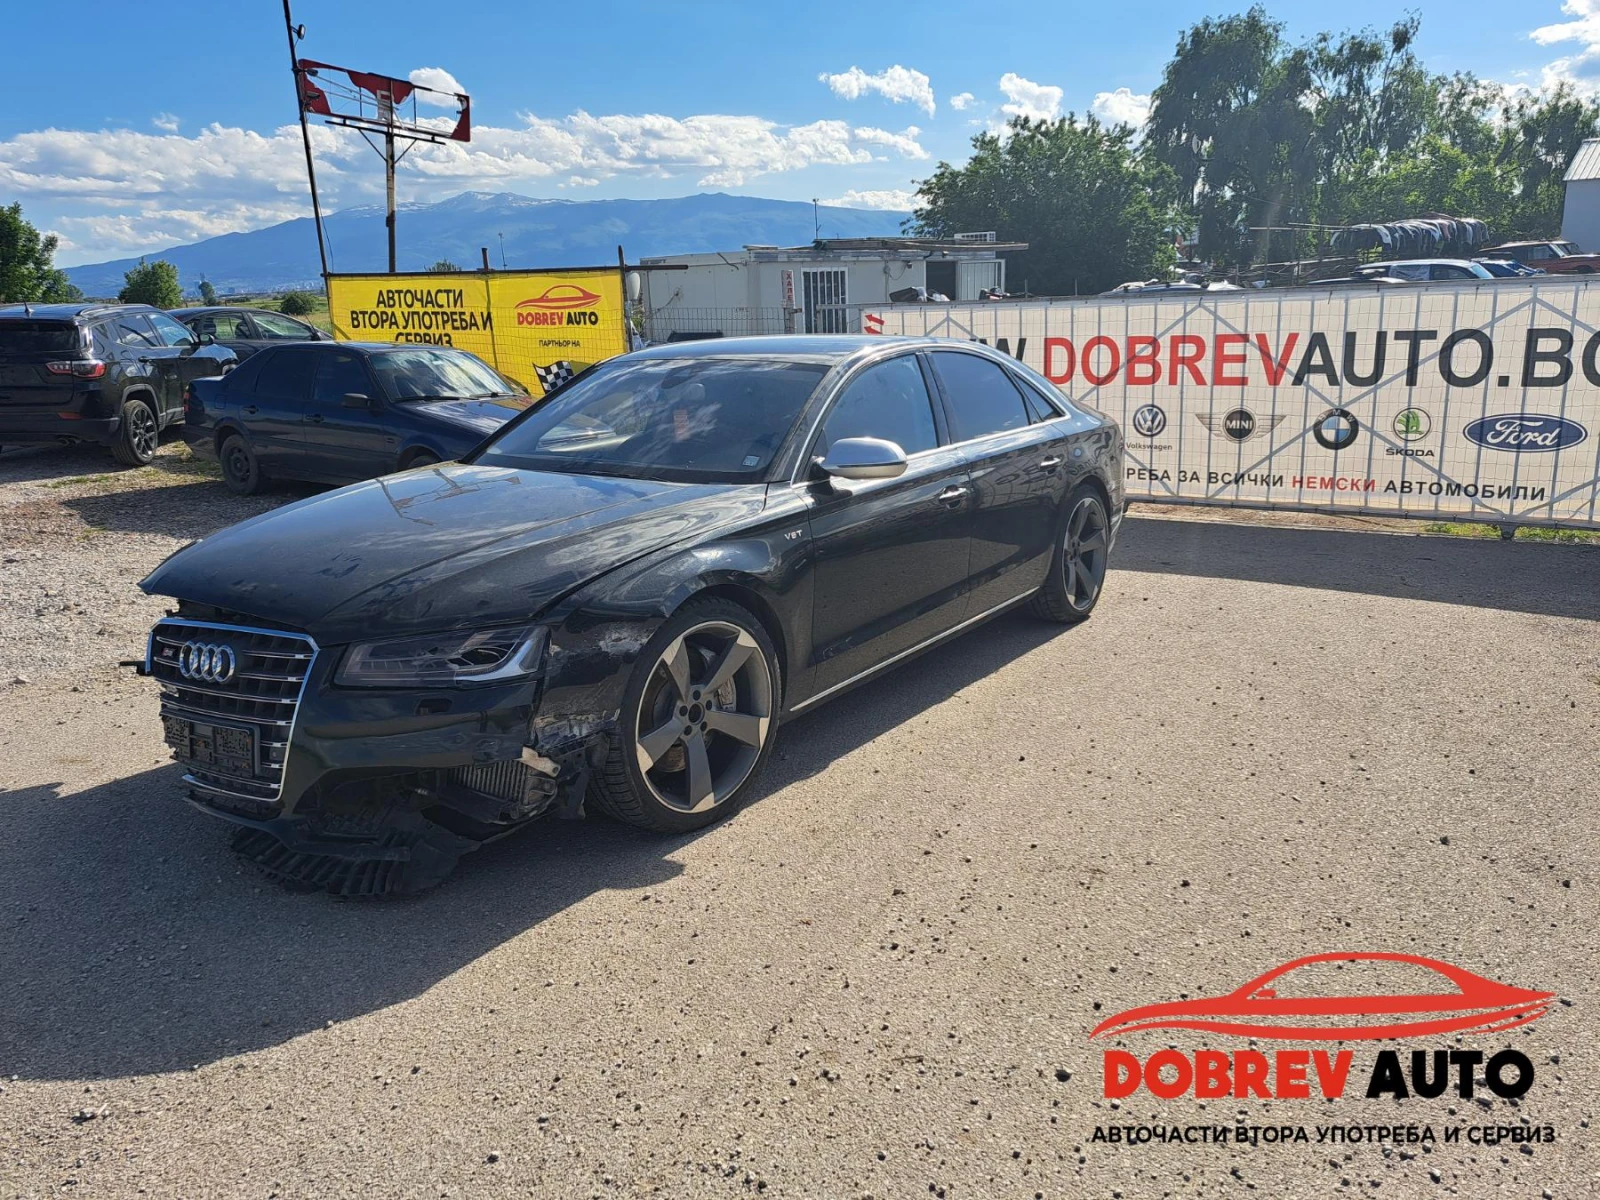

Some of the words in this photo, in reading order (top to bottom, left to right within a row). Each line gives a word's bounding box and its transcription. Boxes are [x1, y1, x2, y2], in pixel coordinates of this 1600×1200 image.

[376, 289, 463, 308] АВТОЧАСТИ
[351, 311, 399, 330] ВТОРА
[402, 311, 482, 330] УПОТРЕБА
[482, 312, 493, 331] И
[517, 312, 563, 325] DOBREV
[566, 312, 598, 325] AUTO
[969, 327, 1600, 388] DOBREVAUTO.B
[1226, 420, 1252, 429] MINI
[1486, 420, 1562, 445] Ford
[1126, 442, 1172, 451] Volkswagen
[1178, 469, 1200, 483] ЗА
[1208, 470, 1283, 487] ВСИЧКИ
[1292, 476, 1376, 492] НЕМСКИ
[1384, 479, 1546, 501] АВТОМОБИЛИ
